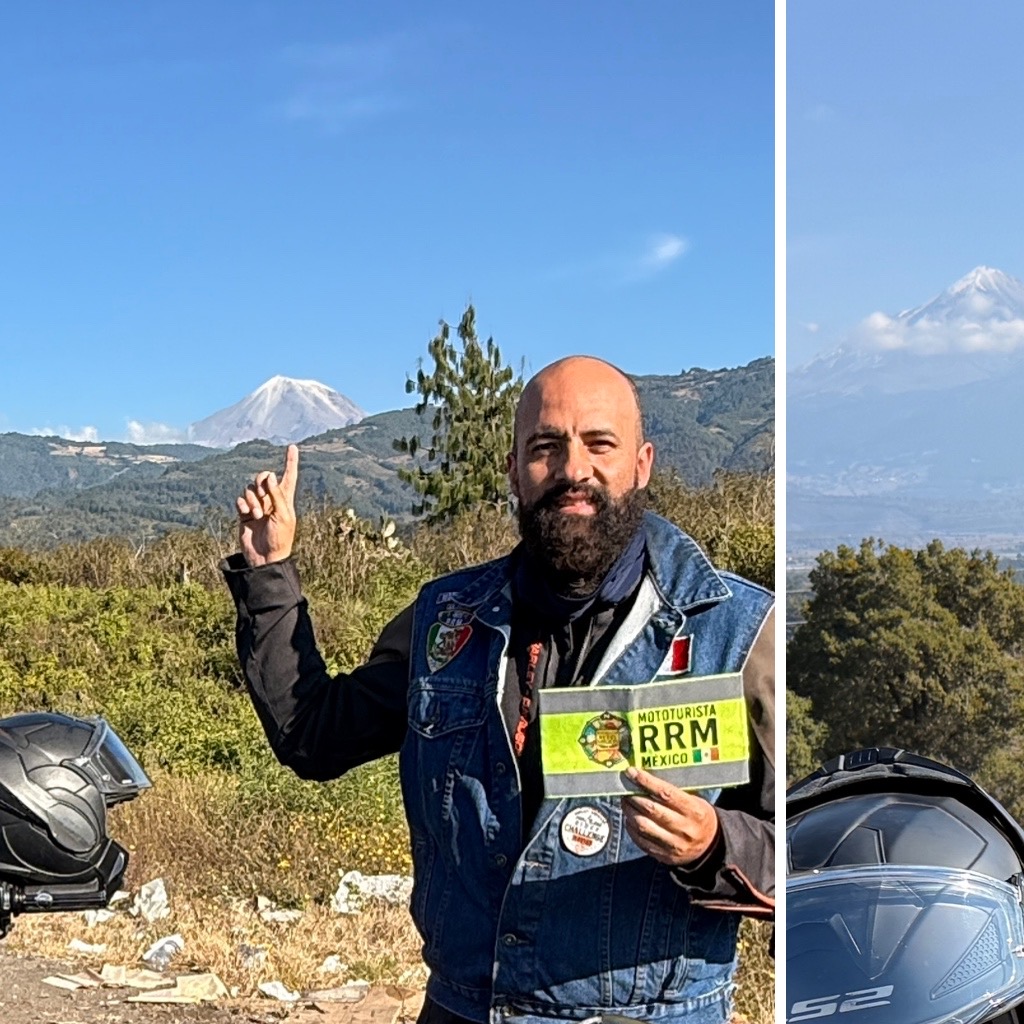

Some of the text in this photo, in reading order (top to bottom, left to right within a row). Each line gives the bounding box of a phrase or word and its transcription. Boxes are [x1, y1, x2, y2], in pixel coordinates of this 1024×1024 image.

[638, 704, 717, 723] MOTOTURISTA
[639, 718, 719, 753] RRM
[787, 985, 894, 1022] S2
